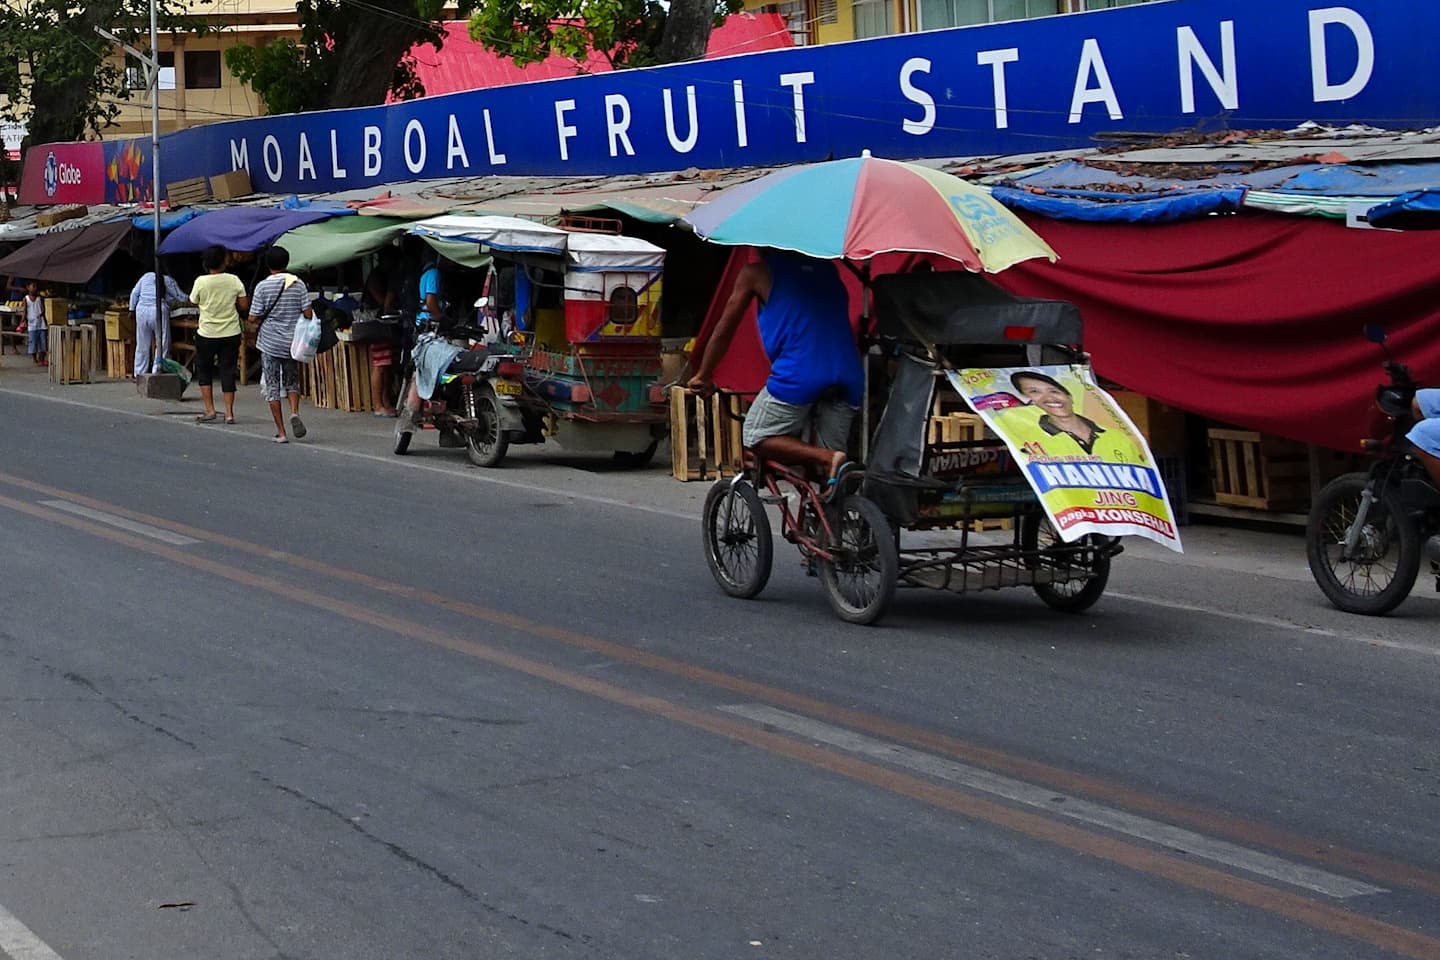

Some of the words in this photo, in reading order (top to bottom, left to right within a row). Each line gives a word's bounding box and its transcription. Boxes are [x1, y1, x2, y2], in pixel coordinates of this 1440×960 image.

[230, 109, 508, 176] MOALBOAL
[555, 71, 816, 161] FRUIT
[900, 6, 1375, 136] STAND
[59, 163, 82, 184] Globe
[1094, 491, 1137, 506] JING
[1060, 509, 1095, 528] pagka
[1095, 509, 1175, 537] KONSEHAL
